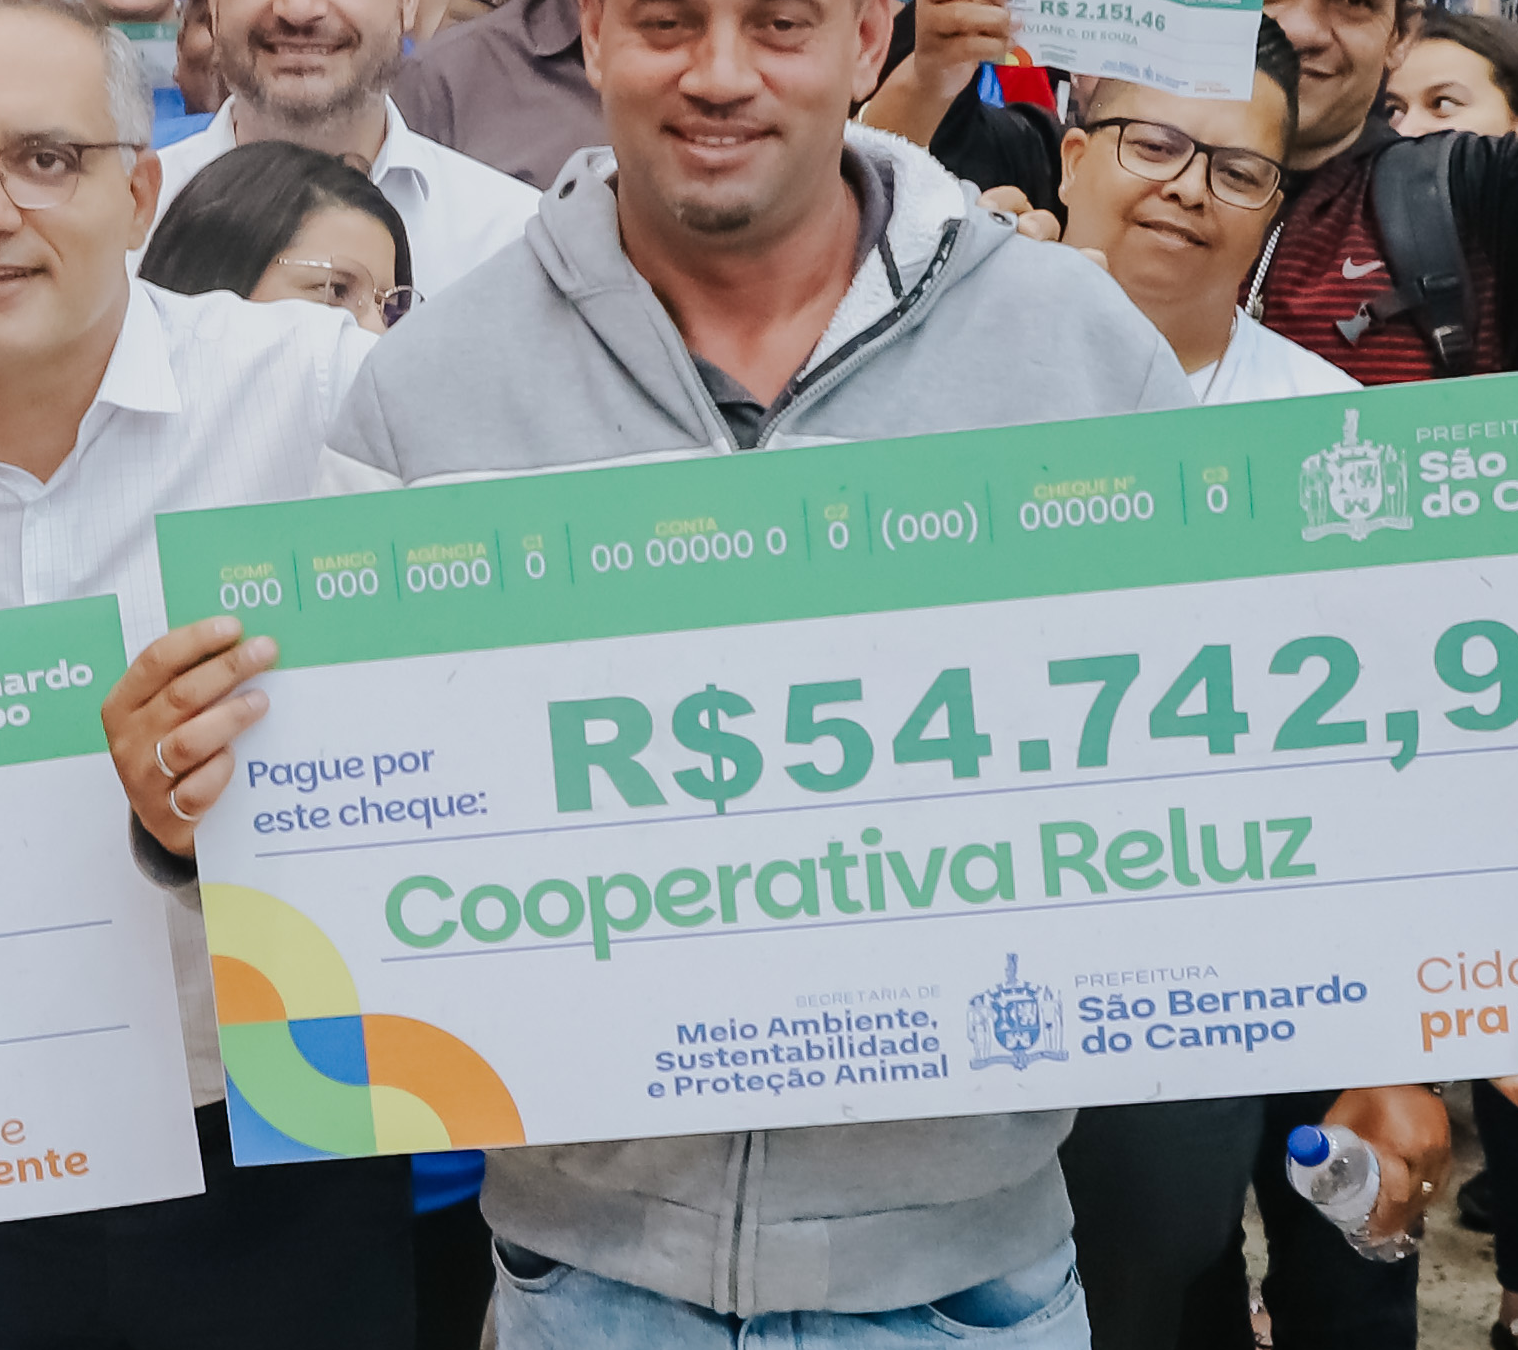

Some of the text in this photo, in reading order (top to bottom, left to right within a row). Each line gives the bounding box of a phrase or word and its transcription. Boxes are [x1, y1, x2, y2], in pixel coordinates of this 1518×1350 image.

[1040, 0, 1166, 31] R$ 2.151,46
[1419, 448, 1506, 485] São
[1034, 479, 1110, 501] CHEQUE
[1422, 483, 1480, 519] do
[655, 516, 718, 537] CONTA
[220, 577, 282, 611] 000
[316, 568, 379, 601] 000
[406, 557, 491, 593] 0000
[881, 501, 978, 552] (000)
[1020, 491, 1155, 531] 000000
[247, 745, 435, 796] Pague por
[252, 788, 489, 835] este cheque:
[384, 807, 1317, 962] Cooperativa Reluz
[795, 985, 940, 1008] SECRETARIA DE
[1074, 965, 1219, 989] PREFEITURA
[1078, 974, 1368, 1024] São Bernardo
[676, 1008, 938, 1046] Meio Ambiente,
[1081, 1016, 1296, 1055] do Campo
[1420, 1003, 1510, 1054] pra
[655, 1032, 941, 1073] Sustentabilidade
[648, 1054, 950, 1098] e Proteção Animal
